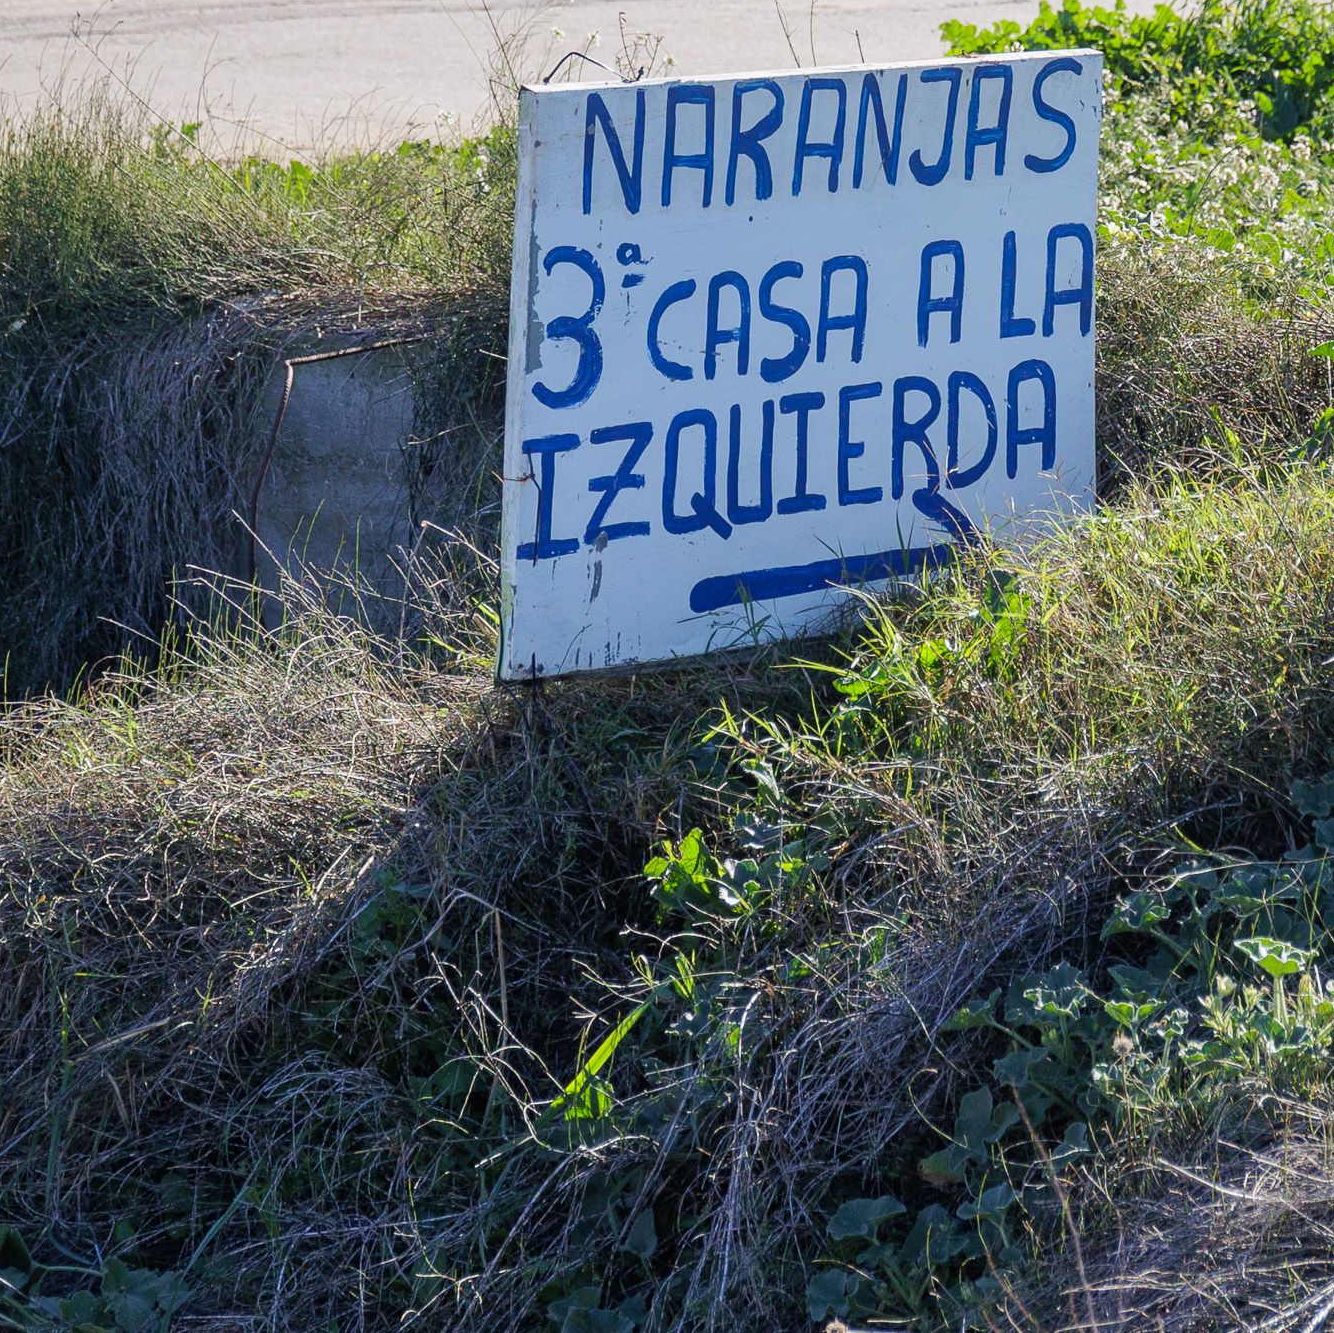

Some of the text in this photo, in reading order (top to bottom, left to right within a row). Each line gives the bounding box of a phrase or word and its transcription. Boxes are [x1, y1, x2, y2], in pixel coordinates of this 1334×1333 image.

[582, 57, 1083, 215] NARANJAS
[647, 254, 869, 383] CASA
[916, 239, 966, 348] A
[999, 222, 1094, 339] LA
[516, 358, 1056, 560] IZQUIERDA
